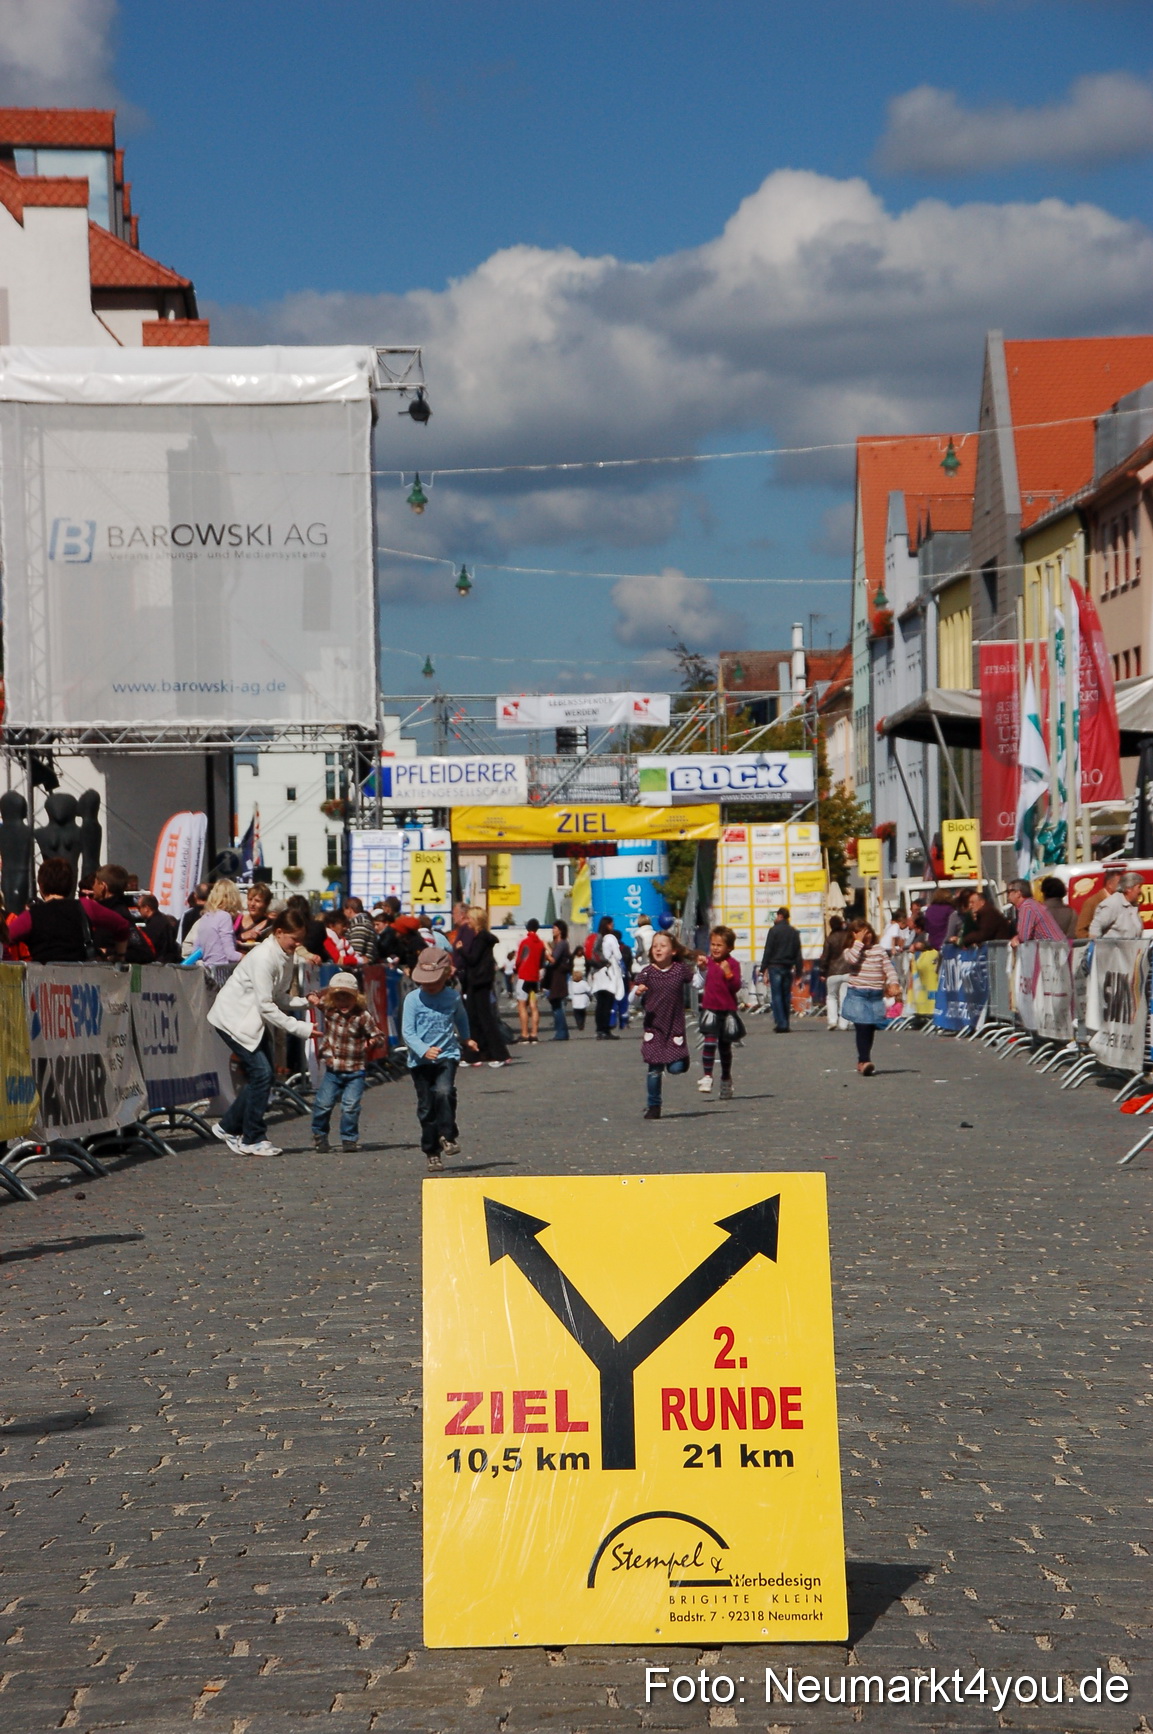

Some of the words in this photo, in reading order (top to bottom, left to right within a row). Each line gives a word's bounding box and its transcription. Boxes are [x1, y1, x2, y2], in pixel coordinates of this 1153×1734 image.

[107, 523, 272, 547] BAROWSKI
[284, 522, 328, 546] AG
[208, 549, 230, 560] und
[234, 549, 328, 561] Mediensysteme
[112, 679, 287, 695] www.barowski-ag.de
[396, 763, 518, 784] PFLEIDERER
[670, 763, 788, 791] BOCK
[396, 786, 519, 799] AKTIENGESELLSCHAFT
[720, 792, 792, 801] www.bockonline.de
[556, 813, 616, 833] ZIEL
[947, 822, 976, 833] Block
[415, 853, 443, 864] Block
[953, 836, 972, 861] A
[418, 868, 438, 893] A
[713, 1325, 748, 1370] 2.
[444, 1389, 589, 1436] ZIEL
[661, 1386, 804, 1432] RUNDE
[447, 1446, 523, 1478] 10,5
[537, 1446, 591, 1472] km
[683, 1443, 722, 1469] 21
[740, 1443, 795, 1469] km
[611, 1541, 704, 1579] Stempel
[729, 1572, 822, 1591] Werbedesign
[669, 1594, 750, 1605] BRIGITTE
[772, 1593, 824, 1604] KLEIN
[669, 1611, 706, 1622] Badstr.
[710, 1611, 717, 1622] 7
[728, 1611, 765, 1622] 92318
[768, 1610, 824, 1622] Neumarkt
